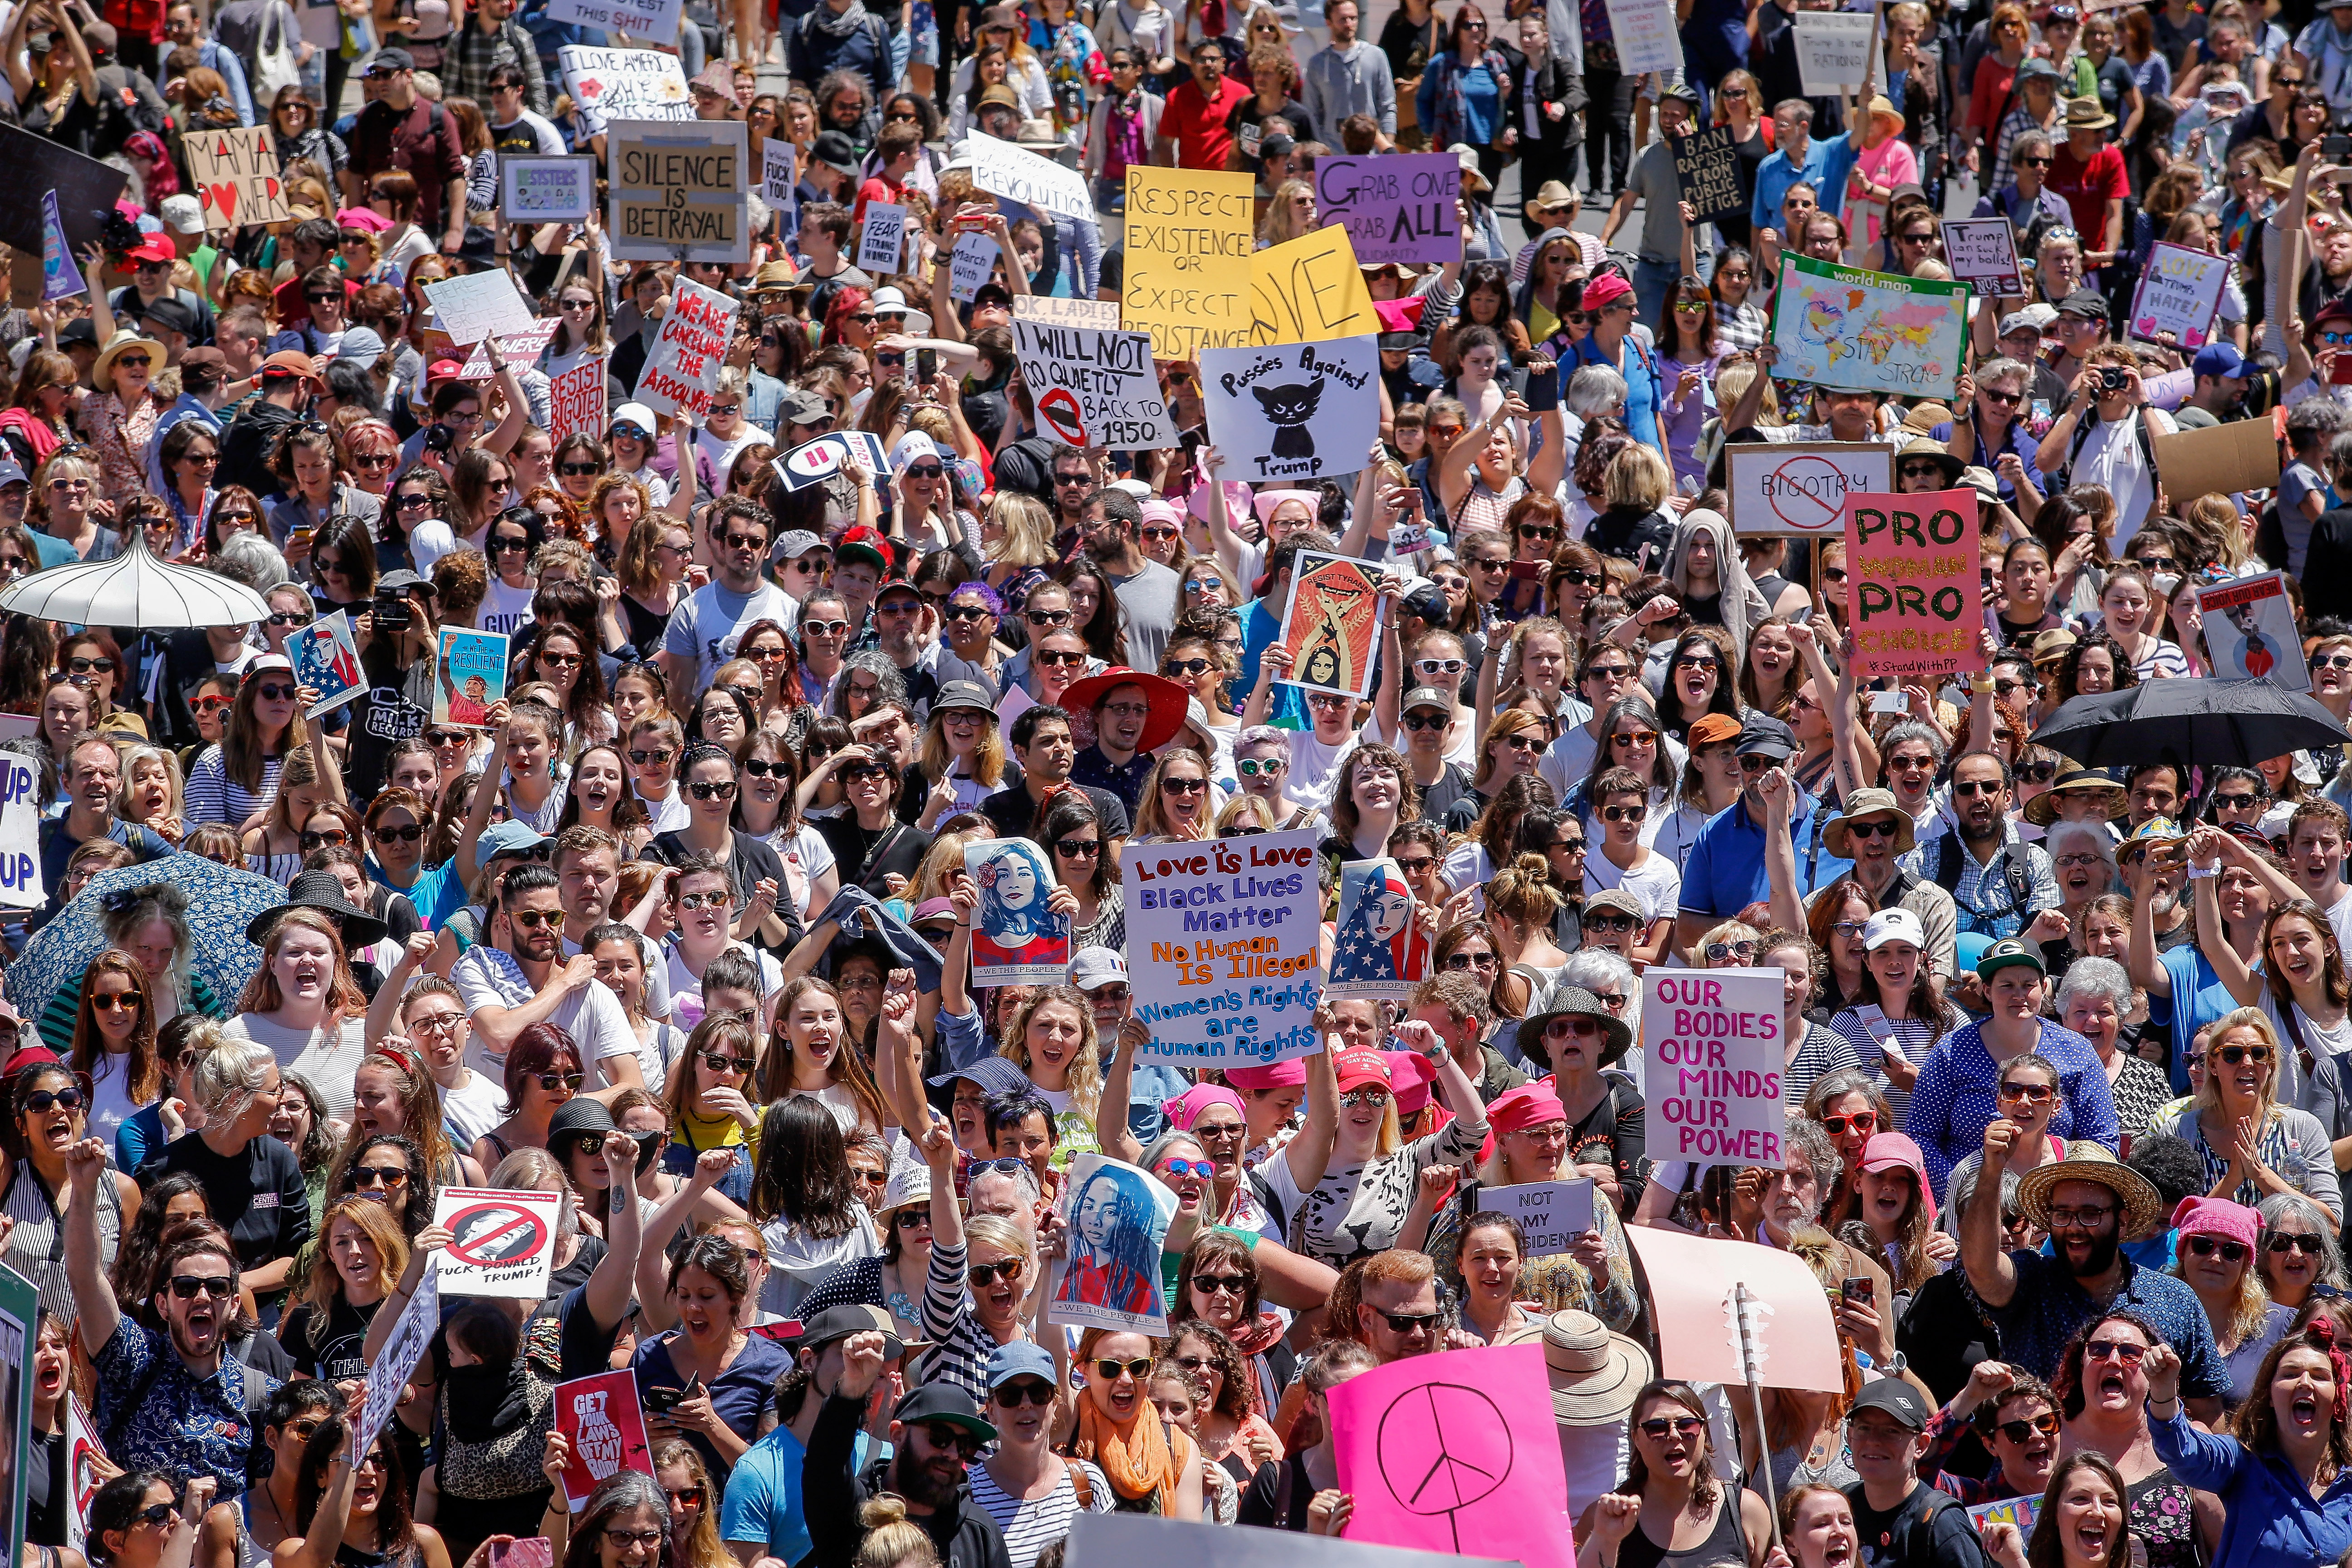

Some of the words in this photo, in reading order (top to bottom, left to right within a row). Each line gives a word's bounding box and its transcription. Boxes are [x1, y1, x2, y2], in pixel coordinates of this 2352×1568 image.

[574, 4, 609, 22] THIS
[612, 11, 655, 32] SHIT
[562, 49, 575, 73] I
[578, 51, 620, 71] LOVE
[603, 78, 658, 108] SHE
[1683, 127, 1729, 157] BAN
[187, 131, 278, 179] MAMA
[1676, 146, 1736, 175] RAPISTS
[623, 150, 732, 188] SILENCE
[766, 161, 790, 182] FUCK
[1692, 162, 1735, 186] FROM
[768, 180, 787, 201] YOU
[978, 166, 1095, 221] REVOLUTION
[1128, 171, 1252, 218] RESPECT
[1320, 161, 1401, 206] GRAB
[1412, 170, 1460, 198] ONE
[1683, 178, 1736, 203] PUBLIC
[665, 187, 686, 209] IS
[626, 206, 732, 242] BETRAYAL
[868, 220, 900, 240] FEAR
[1389, 203, 1454, 244] ALL
[1950, 225, 2004, 245] Trump
[865, 238, 896, 252] STRONG
[970, 238, 976, 249] I
[1128, 224, 1250, 258] EXISTENCE
[1952, 244, 1974, 254] can
[1975, 244, 2004, 255] suck
[864, 249, 893, 265] WOMEN
[953, 248, 987, 266] March
[1174, 255, 1203, 272] OR
[1354, 248, 1420, 262] OLIDARITY
[1955, 254, 1975, 269] my
[1977, 252, 2011, 267] balls!
[954, 264, 978, 281] With
[2161, 255, 2209, 281] LOVE
[1126, 271, 1239, 317] EXPECT
[1833, 270, 1876, 288] world
[1878, 279, 1912, 294] map
[1975, 276, 2002, 293] NUS
[675, 287, 703, 324] WE
[698, 300, 730, 338] ARE
[1051, 299, 1117, 321] LADIES
[2150, 292, 2201, 318] HATE!
[1016, 322, 1026, 351] I
[1032, 325, 1094, 361] WILL
[1097, 332, 1150, 371] NOT
[1840, 337, 1895, 365] STAY
[676, 348, 704, 378] THE
[1299, 345, 1370, 391] Against
[551, 358, 604, 402] RESIST
[1049, 361, 1123, 397] QUIETLY
[1220, 355, 1283, 398] Pussies
[551, 386, 604, 431] BIGOTED
[1083, 396, 1134, 421] BACK
[1137, 400, 1162, 417] TO
[1083, 421, 1100, 435] THE
[851, 435, 871, 467] EQUAL
[1254, 455, 1323, 476] Trump
[1761, 473, 1868, 498] BIGOTRY
[1854, 508, 1965, 548] PRO
[1857, 554, 1967, 580] WOMAN
[1307, 573, 1336, 585] RESIST
[1337, 574, 1374, 597] TYRANNY
[2232, 588, 2252, 603] OUR
[2253, 581, 2279, 600] HEAR
[1858, 581, 1964, 622] PRO
[2204, 593, 2232, 609] VOICE
[469, 645, 478, 653] WE
[478, 645, 488, 654] THE
[1858, 627, 1971, 655] CHOICE
[454, 652, 501, 672] RESILIENT
[1868, 657, 1958, 673] #StandWithPP
[311, 701, 324, 711] WE
[324, 696, 338, 706] THE
[337, 686, 358, 701] PEOPLE
[372, 721, 423, 737] RECORDS
[0, 853, 34, 892] UP
[1139, 882, 1225, 910] Black
[1232, 873, 1304, 900] Lives
[1183, 905, 1293, 933] Matter
[1152, 942, 1189, 962] No
[1194, 936, 1280, 963] Human
[1176, 962, 1214, 986] Is
[1226, 945, 1318, 980] Illegal
[1376, 981, 1413, 991] PEOPLE
[1656, 978, 1723, 1008] OUR
[1136, 988, 1243, 1025] Women's
[1249, 979, 1320, 1013] Rights
[1205, 1016, 1259, 1038] are
[1674, 1008, 1778, 1040] BODIES
[1142, 1036, 1226, 1058] Human
[1234, 1024, 1318, 1063] Rights
[1658, 1038, 1727, 1068] OUR
[1339, 1053, 1357, 1063] MAKE
[1358, 1051, 1387, 1065] AMERICA
[1347, 1058, 1361, 1066] GAY
[1361, 1056, 1382, 1067] AGAIN
[1679, 1068, 1780, 1100] MINDS
[1662, 1098, 1729, 1128] OUR
[1584, 1135, 1606, 1145] HAVE
[1679, 1126, 1781, 1162] POWER
[897, 1175, 921, 1188] RIGHTS
[897, 1184, 922, 1197] HUMAN
[1519, 1191, 1554, 1207] NOT
[1523, 1212, 1549, 1229] MY
[436, 1263, 474, 1277] FUCK
[481, 1256, 541, 1271] DONALD
[483, 1266, 543, 1284] TRUMP!
[1063, 1303, 1082, 1313] WE
[1085, 1306, 1107, 1317] THE
[1110, 1310, 1151, 1324] PEOPLE
[331, 1358, 370, 1375] THE
[573, 1390, 609, 1416] GET
[578, 1409, 611, 1429] YOUR
[576, 1422, 622, 1446] LAWS
[576, 1440, 602, 1462] OFF
[600, 1436, 622, 1460] MY
[585, 1456, 620, 1481] BODY
